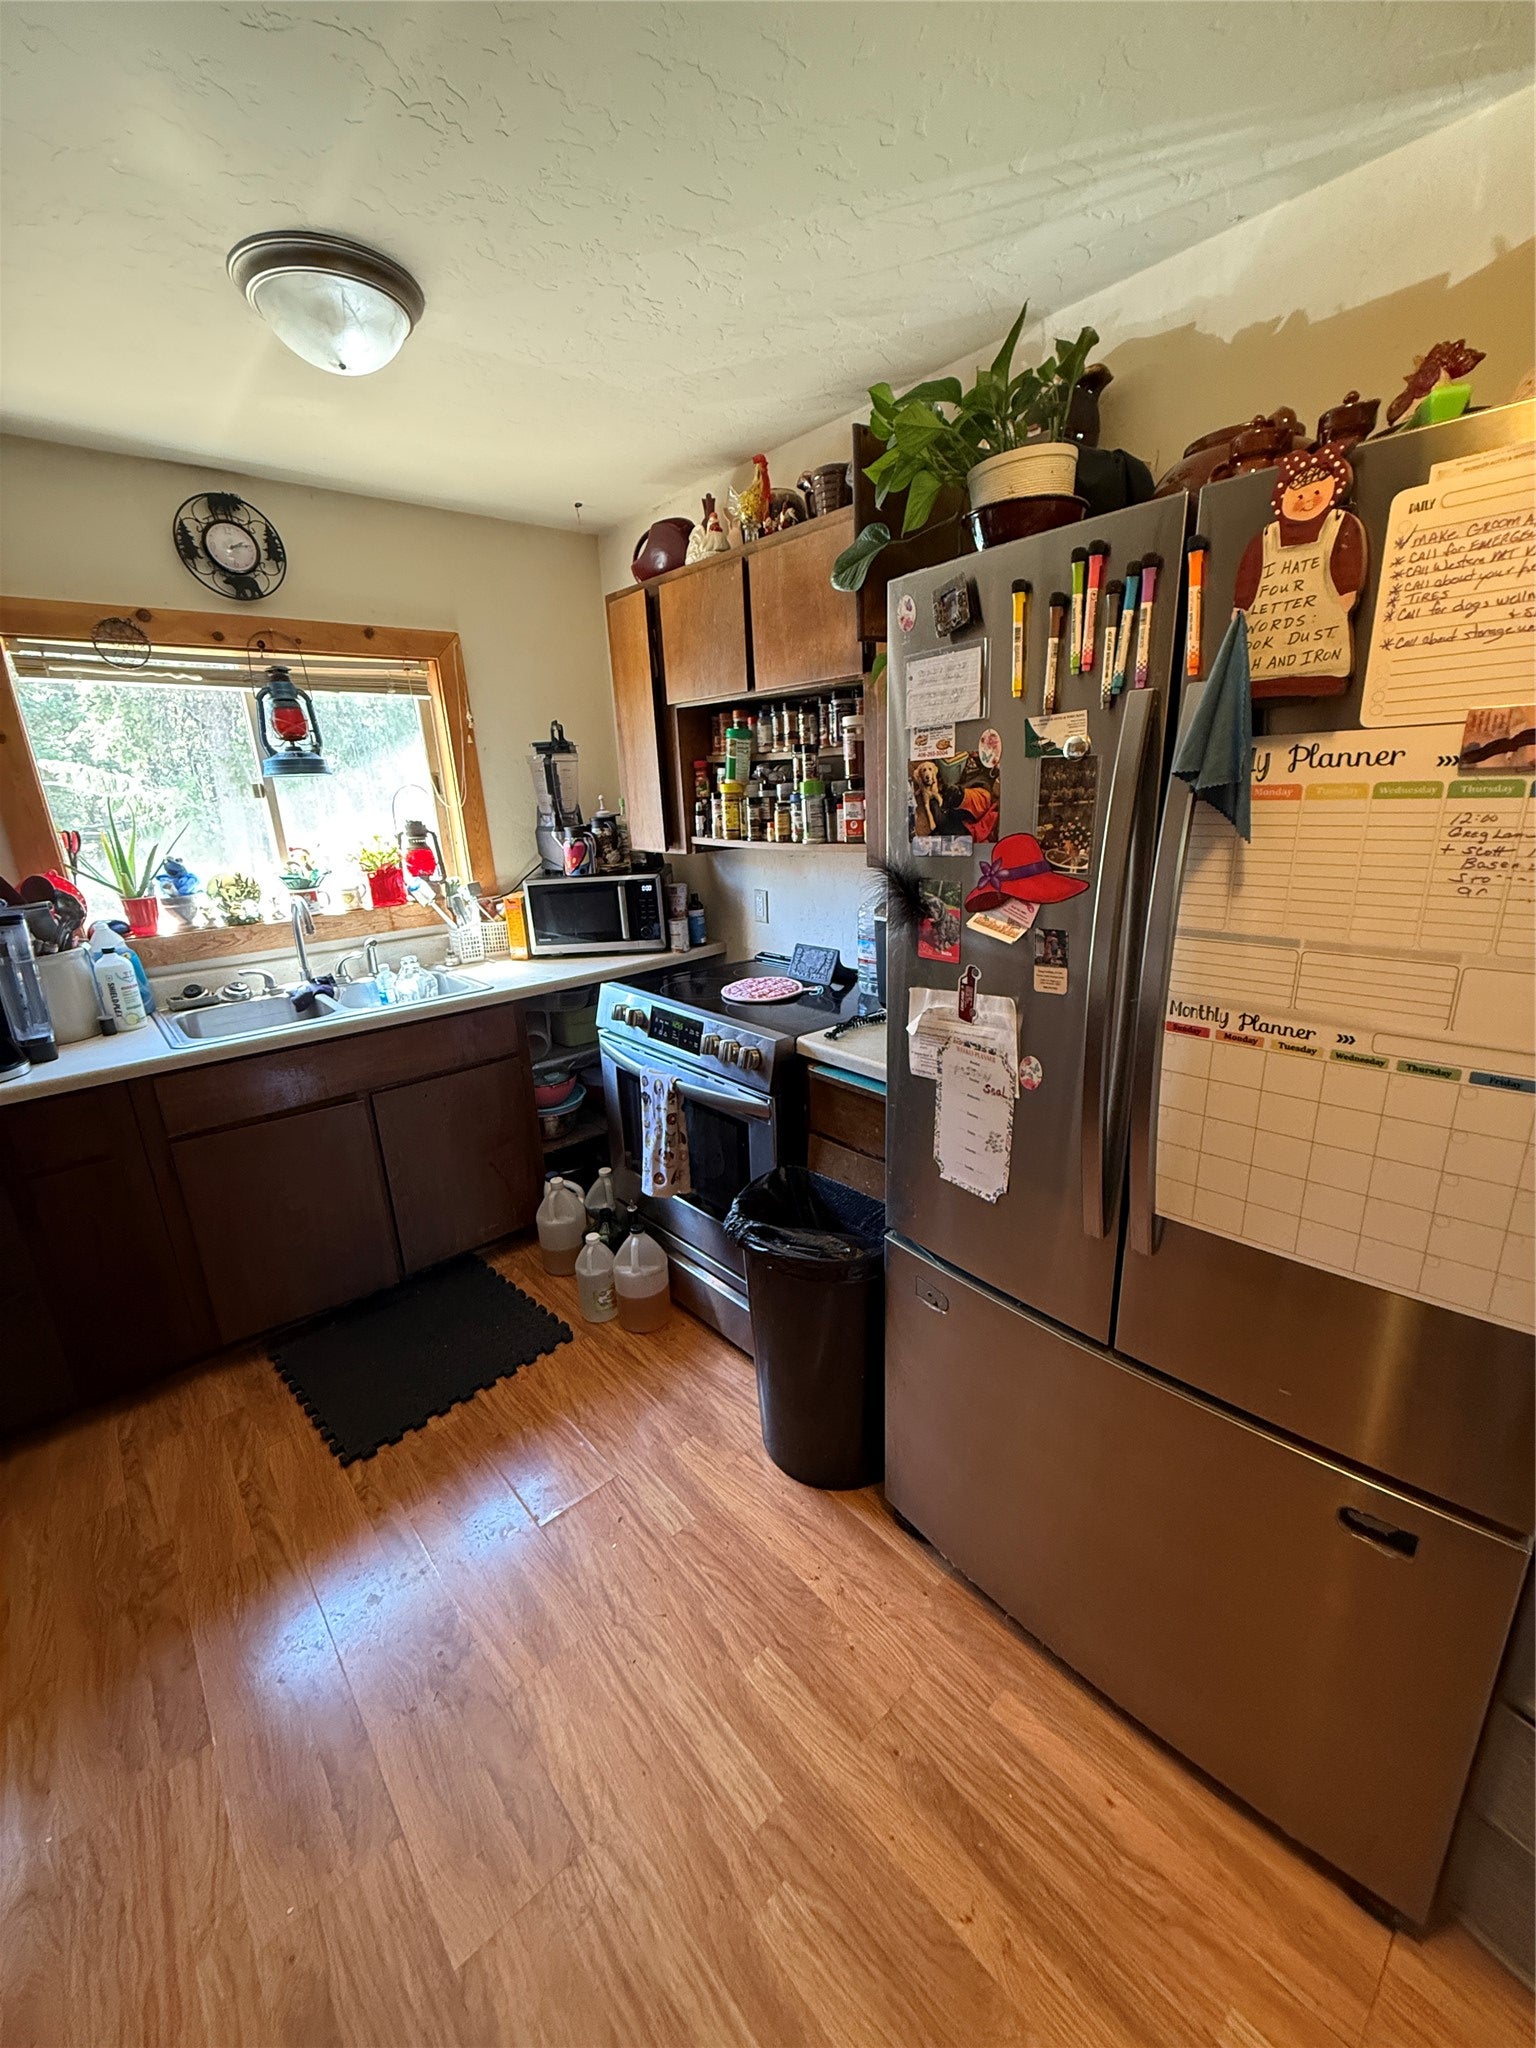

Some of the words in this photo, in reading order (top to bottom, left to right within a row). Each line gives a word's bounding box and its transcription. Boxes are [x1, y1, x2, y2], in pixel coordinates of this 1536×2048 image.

[1408, 498, 1437, 514] DAILY
[1263, 562, 1276, 579] I
[1281, 557, 1320, 574] HATE
[1258, 580, 1304, 598] FOUR
[1251, 595, 1317, 615] LETTER
[1287, 626, 1340, 645] DUST
[1266, 654, 1297, 669] AND
[1300, 648, 1342, 666] IRON
[1288, 743, 1406, 773] Planner
[1254, 787, 1294, 798] Monday
[1379, 785, 1438, 797] Wednesday
[1461, 784, 1514, 795] Thursday
[1169, 1000, 1229, 1029] Monthly
[1238, 1012, 1318, 1040] Planner
[1223, 1032, 1259, 1046] Monday
[1277, 1041, 1318, 1056] Tuesday
[1335, 1051, 1387, 1068] Wednesday
[1405, 1063, 1453, 1080] Thursday
[1488, 1076, 1522, 1090] Friday
